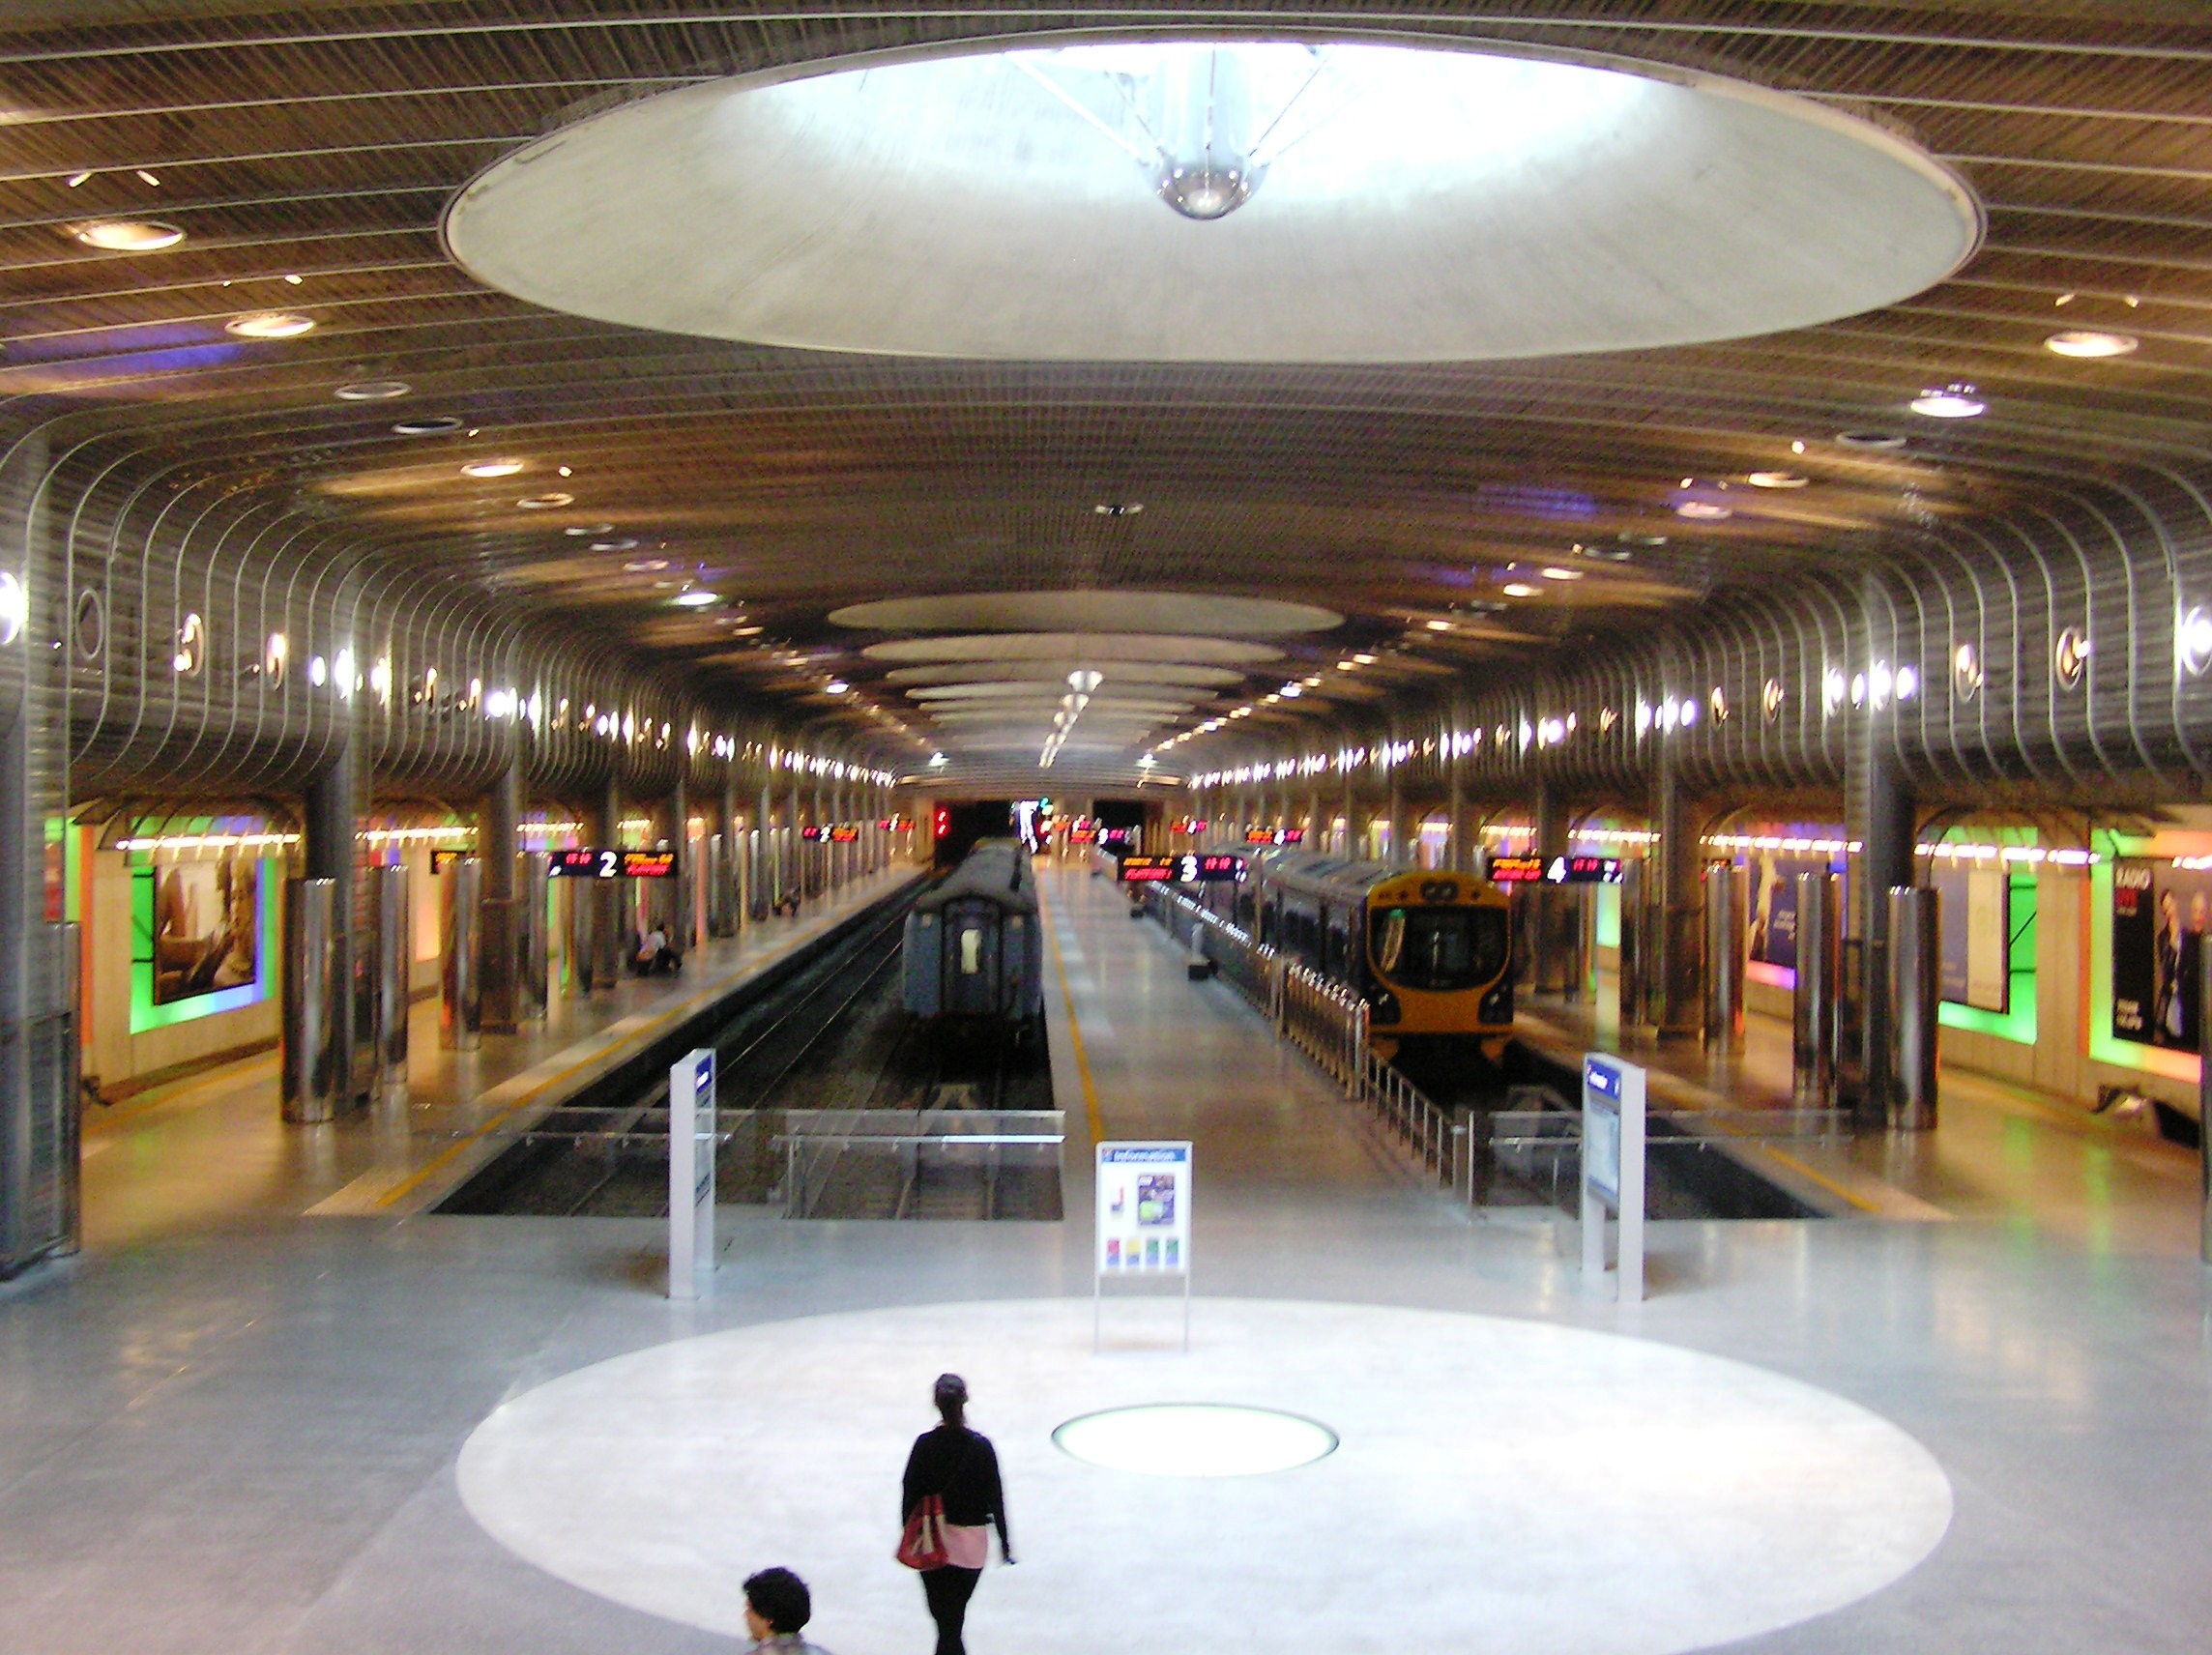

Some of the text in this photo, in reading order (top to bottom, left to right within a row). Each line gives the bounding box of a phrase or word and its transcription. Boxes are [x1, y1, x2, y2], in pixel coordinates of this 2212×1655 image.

[598, 851, 618, 878] 2
[1179, 856, 1198, 883] 3
[1546, 856, 1567, 884] 4
[1113, 1149, 1177, 1162] Information
